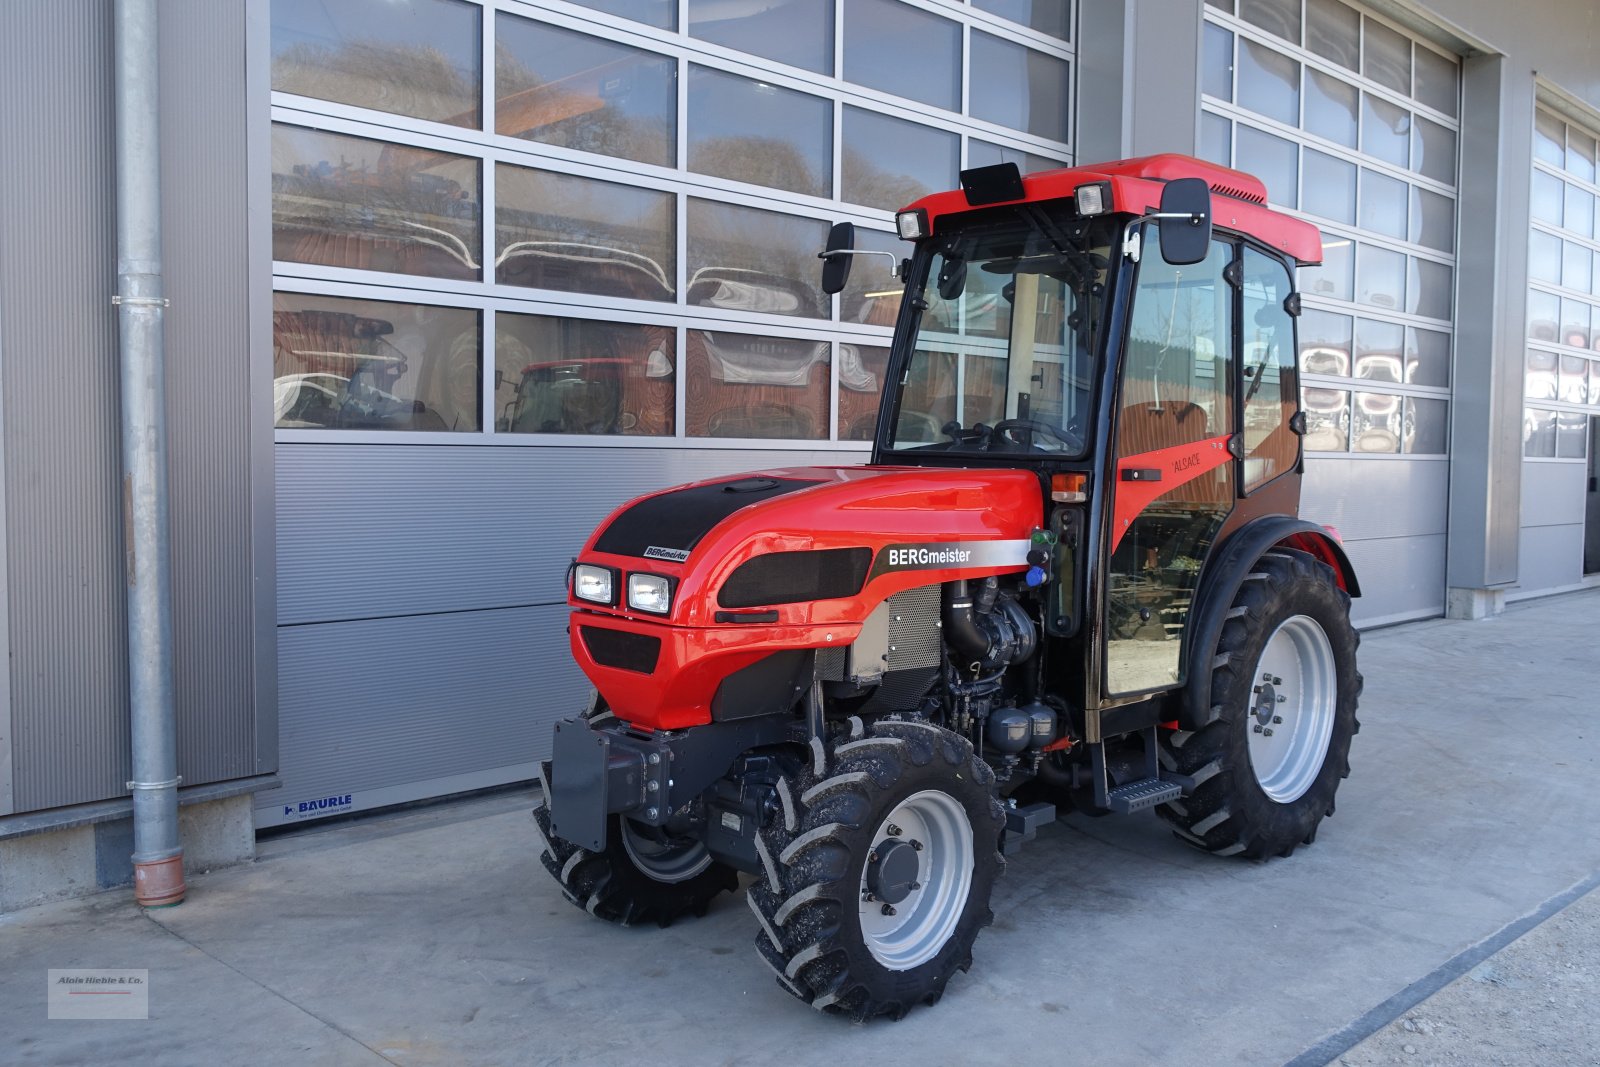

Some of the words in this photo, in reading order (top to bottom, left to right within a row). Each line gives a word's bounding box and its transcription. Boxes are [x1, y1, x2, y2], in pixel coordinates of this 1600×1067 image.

[646, 547, 687, 560] BERGmeister
[889, 548, 971, 566] BERGmeister
[298, 794, 352, 812] BÄURLE
